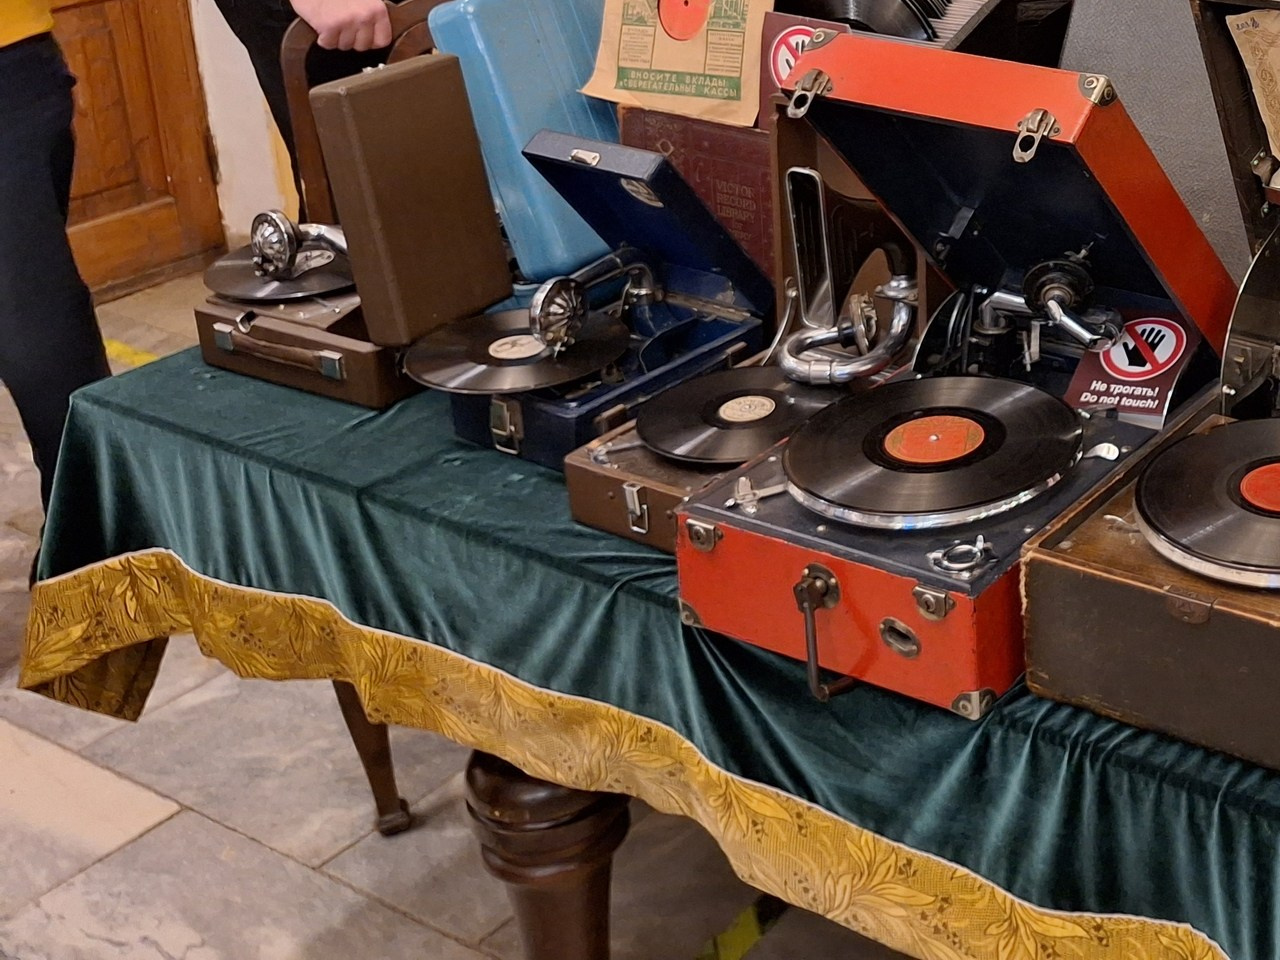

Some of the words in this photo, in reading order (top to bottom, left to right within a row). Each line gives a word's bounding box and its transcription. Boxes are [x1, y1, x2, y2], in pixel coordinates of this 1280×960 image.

[630, 70, 677, 82] ВНОСИТЕ
[685, 75, 726, 87] ВКЛАДЫ
[624, 78, 697, 93] СБЕРЕГАТЕЛЬНЫЕ
[703, 86, 737, 97] КАССЫ
[716, 179, 756, 199] VICTOR
[717, 193, 756, 210] RECORD
[717, 205, 755, 223] LIBRARY
[1090, 380, 1107, 392] Не
[1109, 384, 1160, 397] трогать!
[1080, 392, 1098, 403] Do
[1098, 395, 1119, 405] not
[1121, 397, 1160, 409] touch!
